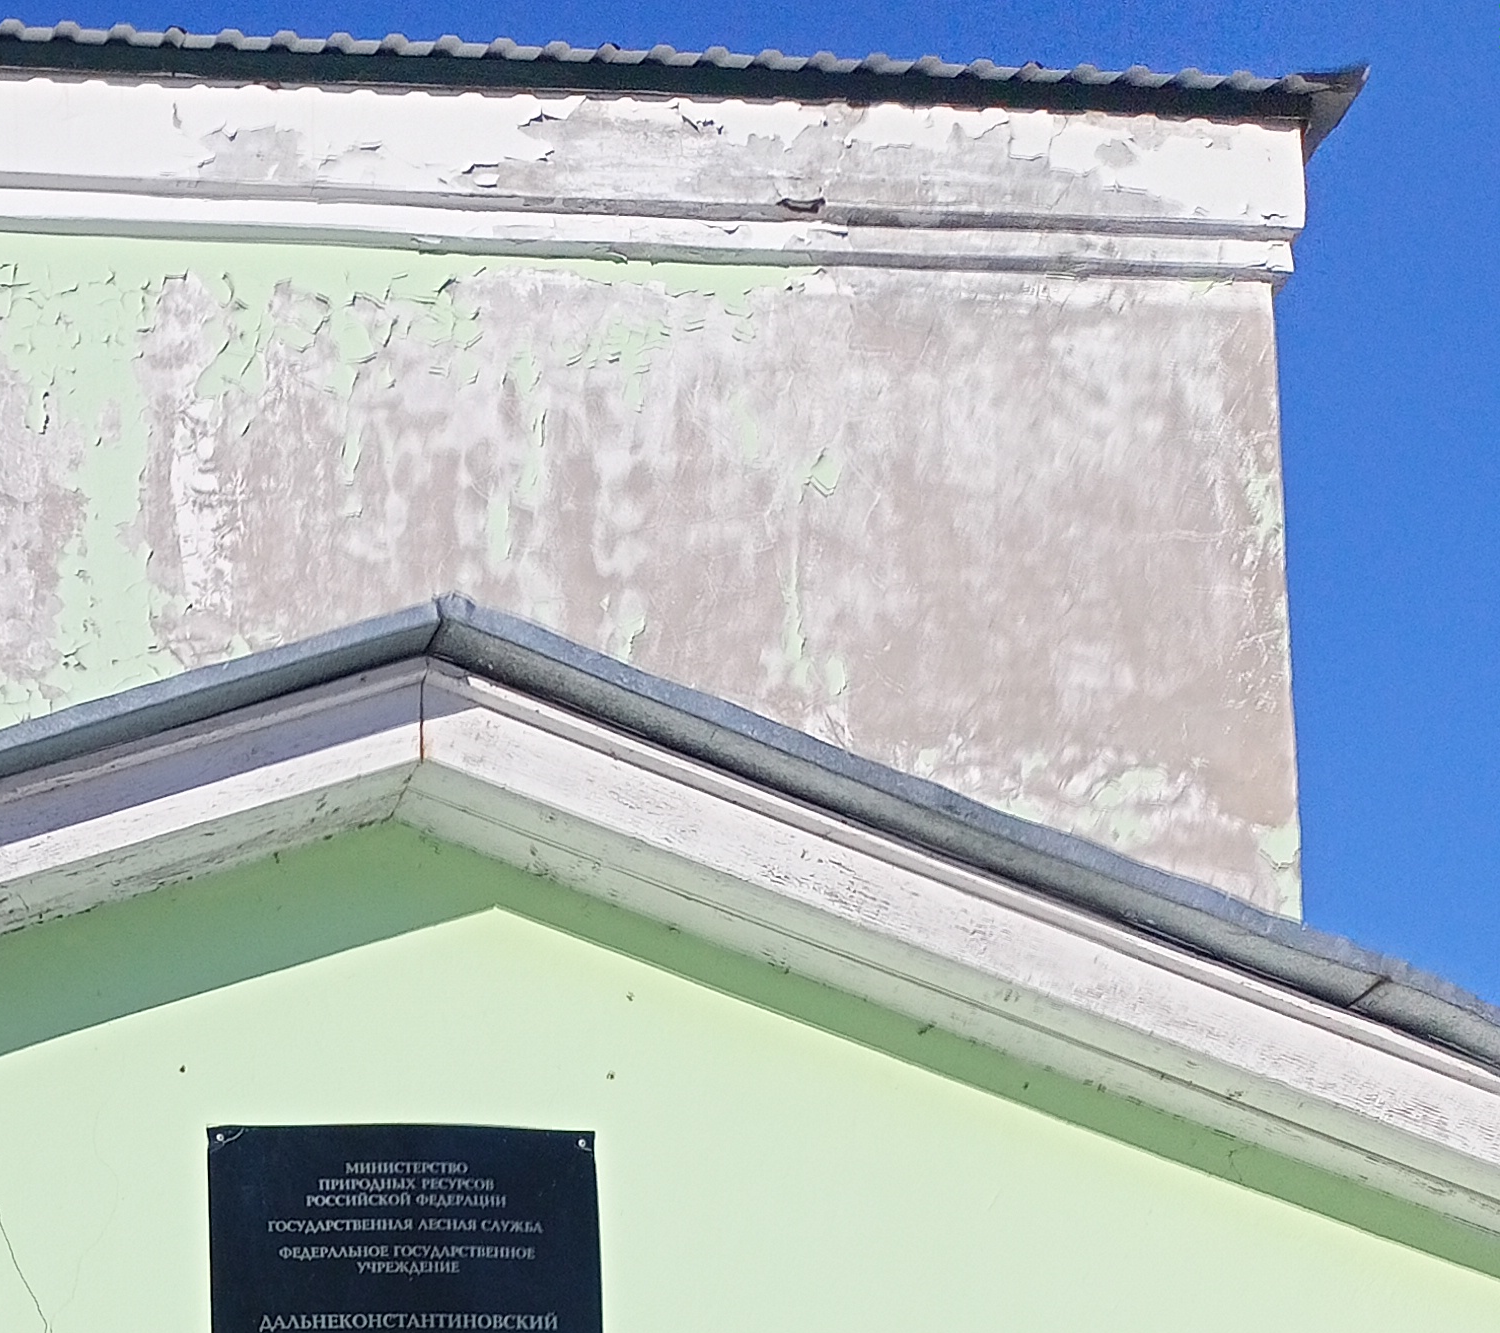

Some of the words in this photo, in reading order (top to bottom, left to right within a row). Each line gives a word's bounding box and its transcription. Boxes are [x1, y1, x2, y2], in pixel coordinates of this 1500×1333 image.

[345, 1161, 469, 1175] МИНИСТЕРСТВО
[318, 1178, 416, 1193] ПРИРОДНЫХ
[421, 1178, 495, 1192] РЕСУРСОВ
[306, 1191, 411, 1207] РОССИЙСКОЙ
[415, 1194, 506, 1209] ФЕДЕРАЦИИ
[267, 1219, 413, 1234] ГОСУДАРСТВЕННАЯ
[417, 1219, 477, 1232] ЛЕСНАЯ
[481, 1220, 543, 1234] СЛУЖБА
[278, 1246, 389, 1262] ФЕДЕРАЛЬНОЕ
[393, 1246, 536, 1261] ГОСУДАРСТВЕННОЕ
[357, 1261, 461, 1275] УЧРЕЖДЕНИЕ
[259, 1311, 559, 1333] ДАЛЬНЕКОНСТАНТИНОВСКИЙ
